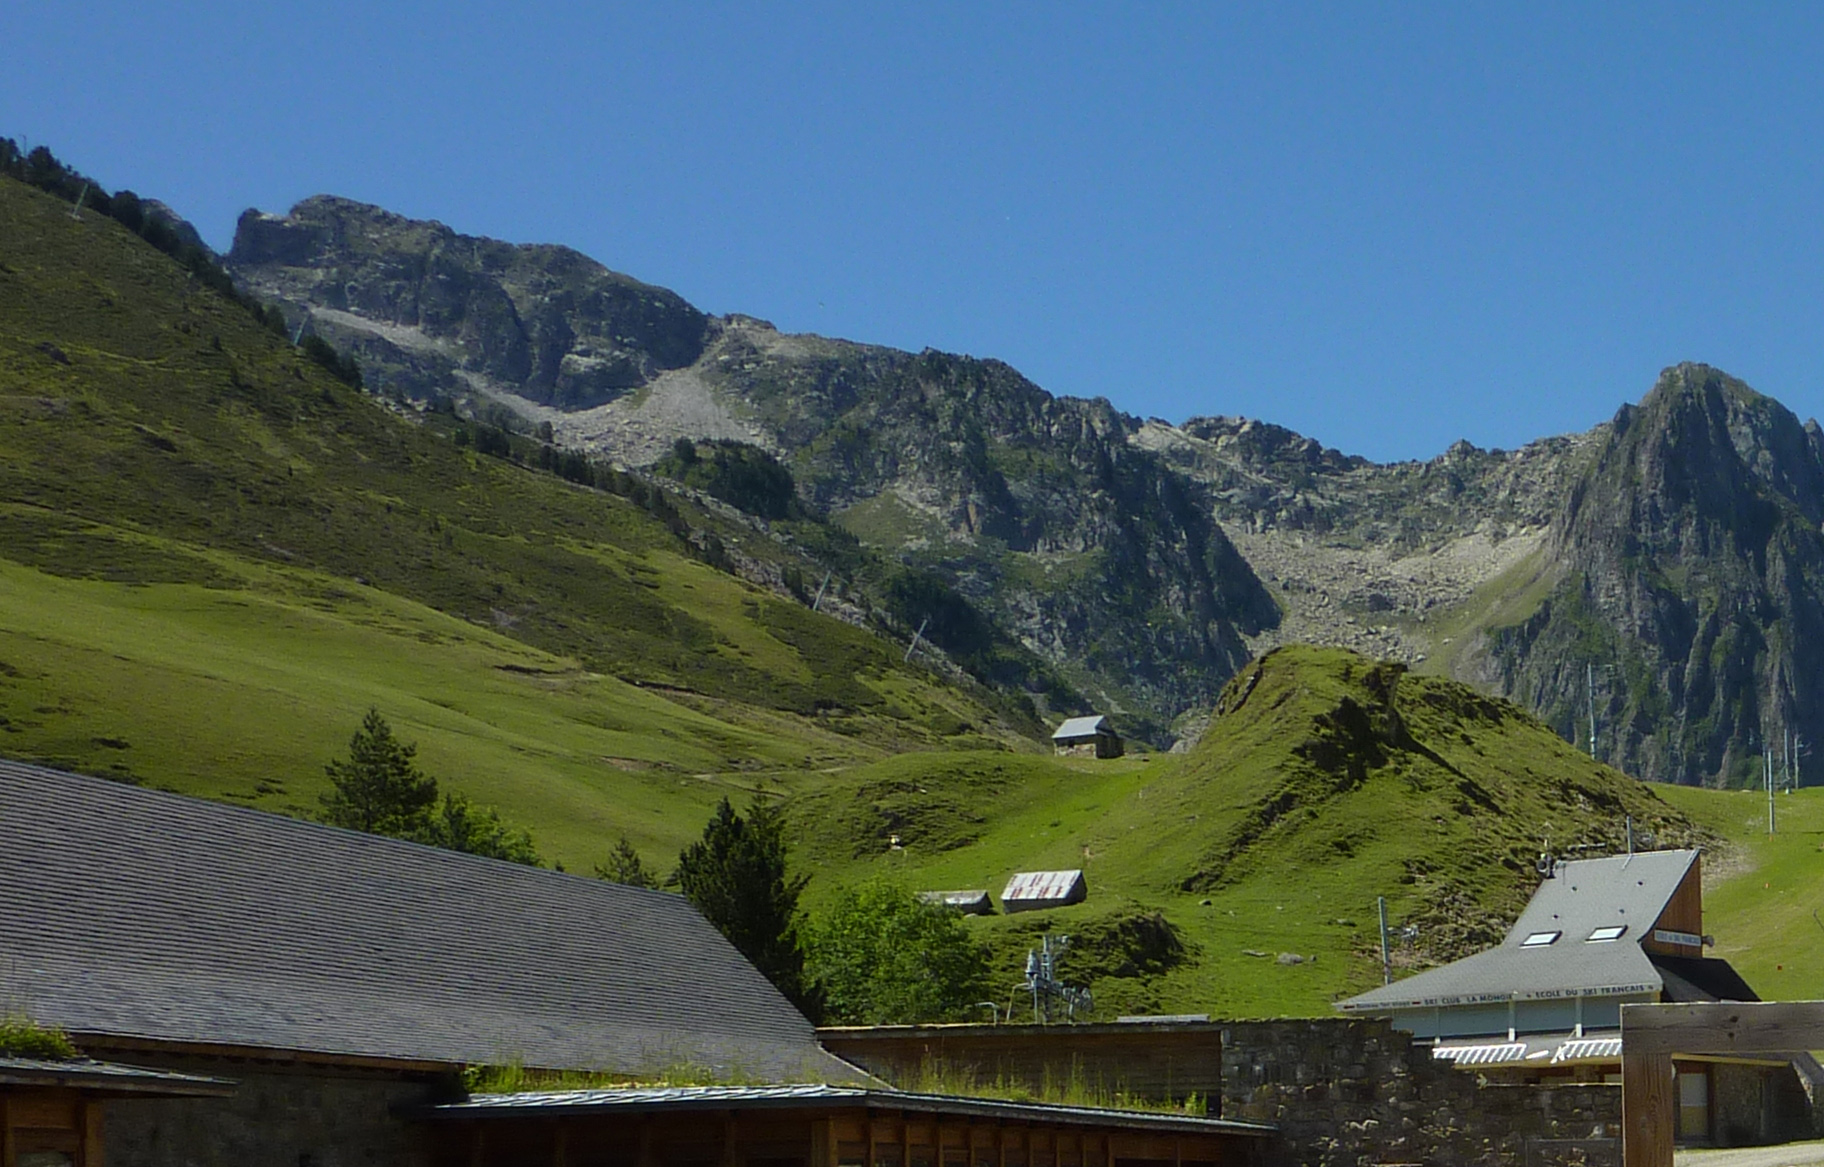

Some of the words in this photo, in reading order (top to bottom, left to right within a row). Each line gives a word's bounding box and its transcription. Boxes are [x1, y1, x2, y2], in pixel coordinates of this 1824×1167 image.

[1535, 989, 1560, 999] ECOLE
[1565, 988, 1578, 996] DU
[1583, 987, 1597, 996] SKI
